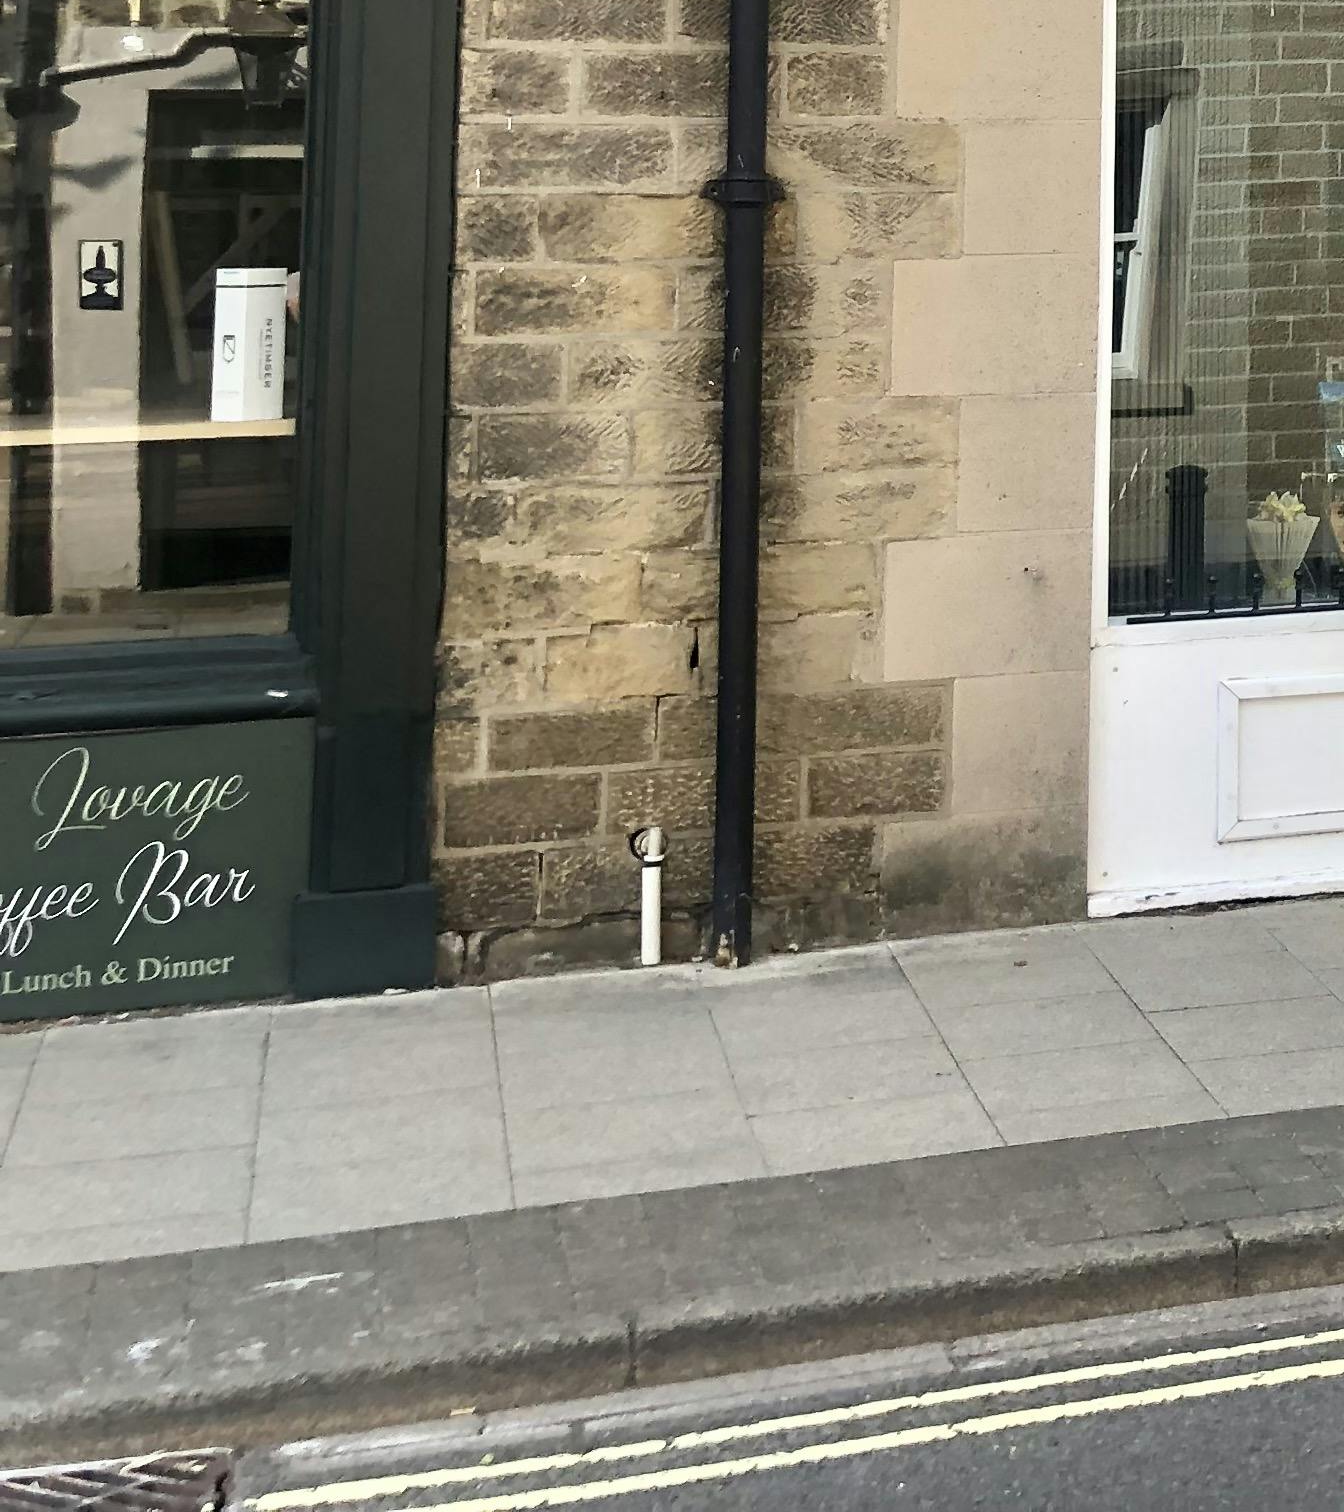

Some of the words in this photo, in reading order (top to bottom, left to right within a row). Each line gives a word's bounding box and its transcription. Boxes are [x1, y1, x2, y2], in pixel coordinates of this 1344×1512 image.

[263, 318, 273, 389] NYETIMBER
[31, 746, 251, 851] Lovage
[112, 840, 256, 946] Bar
[1, 964, 92, 996] Lunch
[101, 960, 129, 986] &
[136, 953, 235, 984] Dinner
